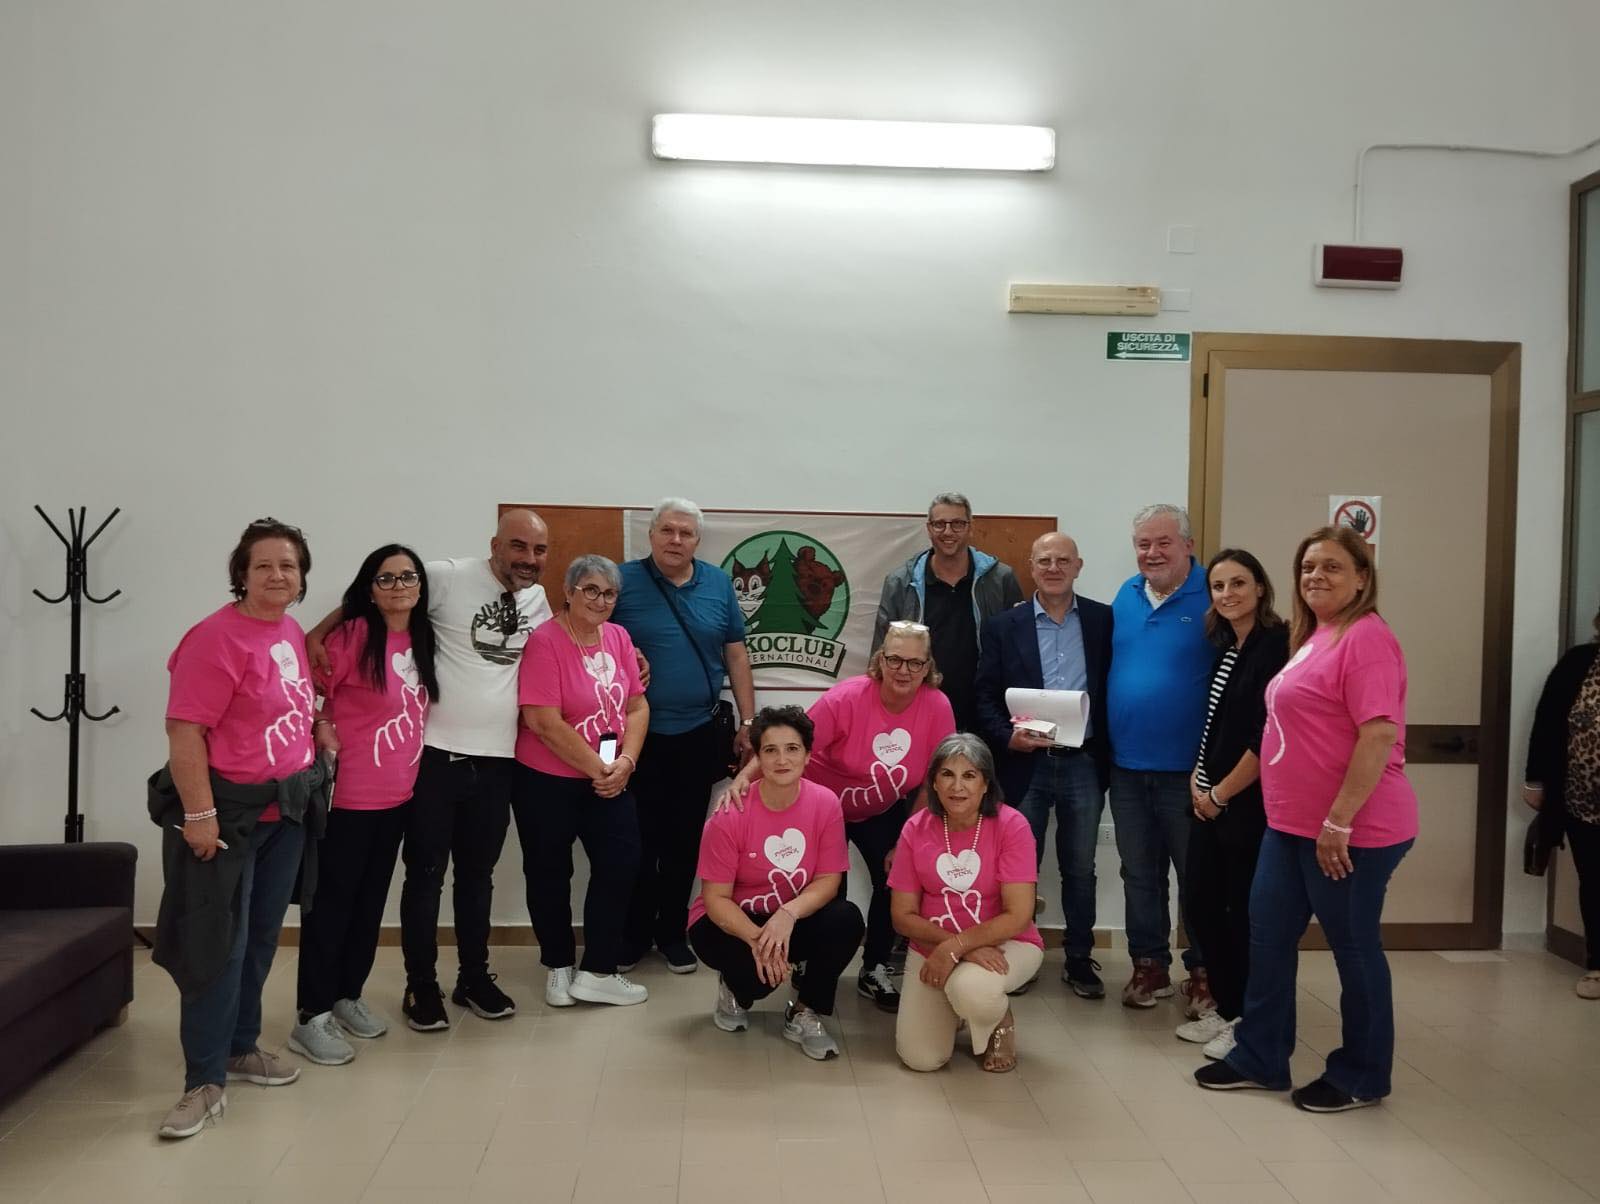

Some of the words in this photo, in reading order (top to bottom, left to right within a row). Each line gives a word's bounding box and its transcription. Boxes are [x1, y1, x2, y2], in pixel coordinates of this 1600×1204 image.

[1121, 333, 1162, 343] USCITA
[1164, 334, 1176, 343] DI
[1116, 342, 1180, 352] SICUREZZA
[744, 635, 836, 659] KOCLUB
[747, 652, 829, 668] ERNATIONAL
